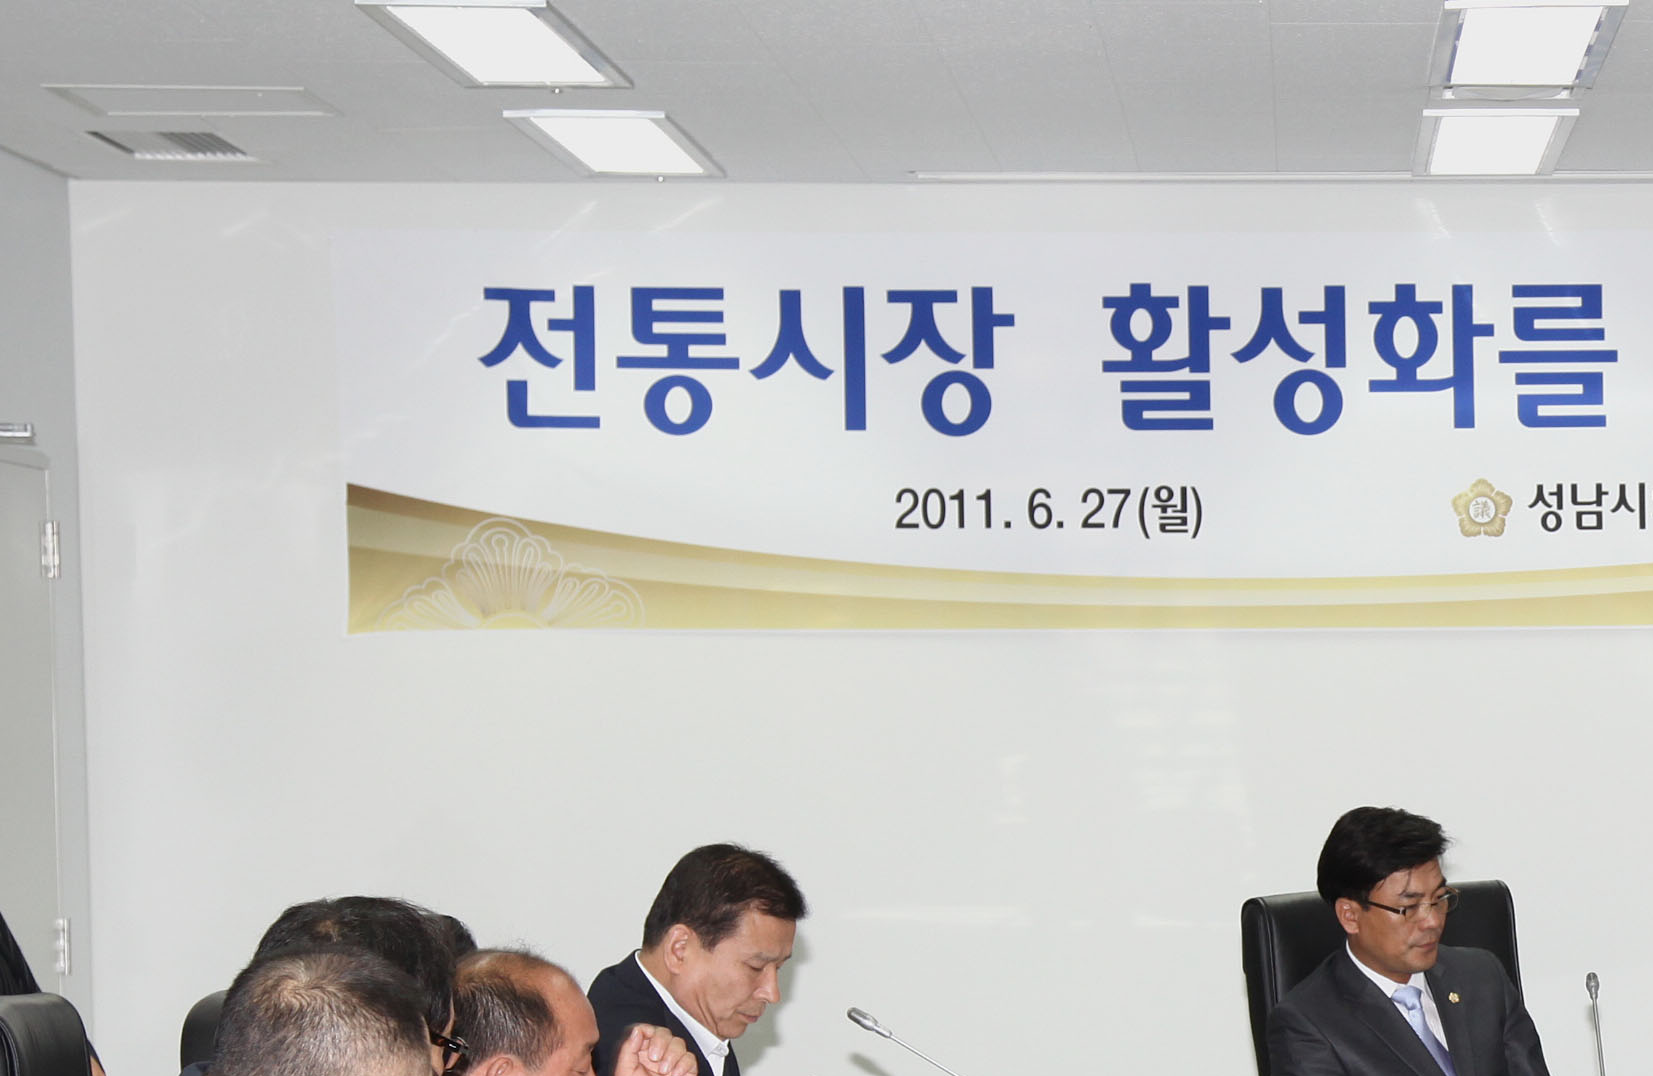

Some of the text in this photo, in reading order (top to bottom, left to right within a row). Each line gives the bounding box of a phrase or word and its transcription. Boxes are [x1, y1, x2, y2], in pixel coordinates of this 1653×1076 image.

[478, 285, 1015, 437] 전통시장
[1102, 283, 1619, 436] 활성화를
[895, 485, 1203, 539] 2011. 6. 27(월)
